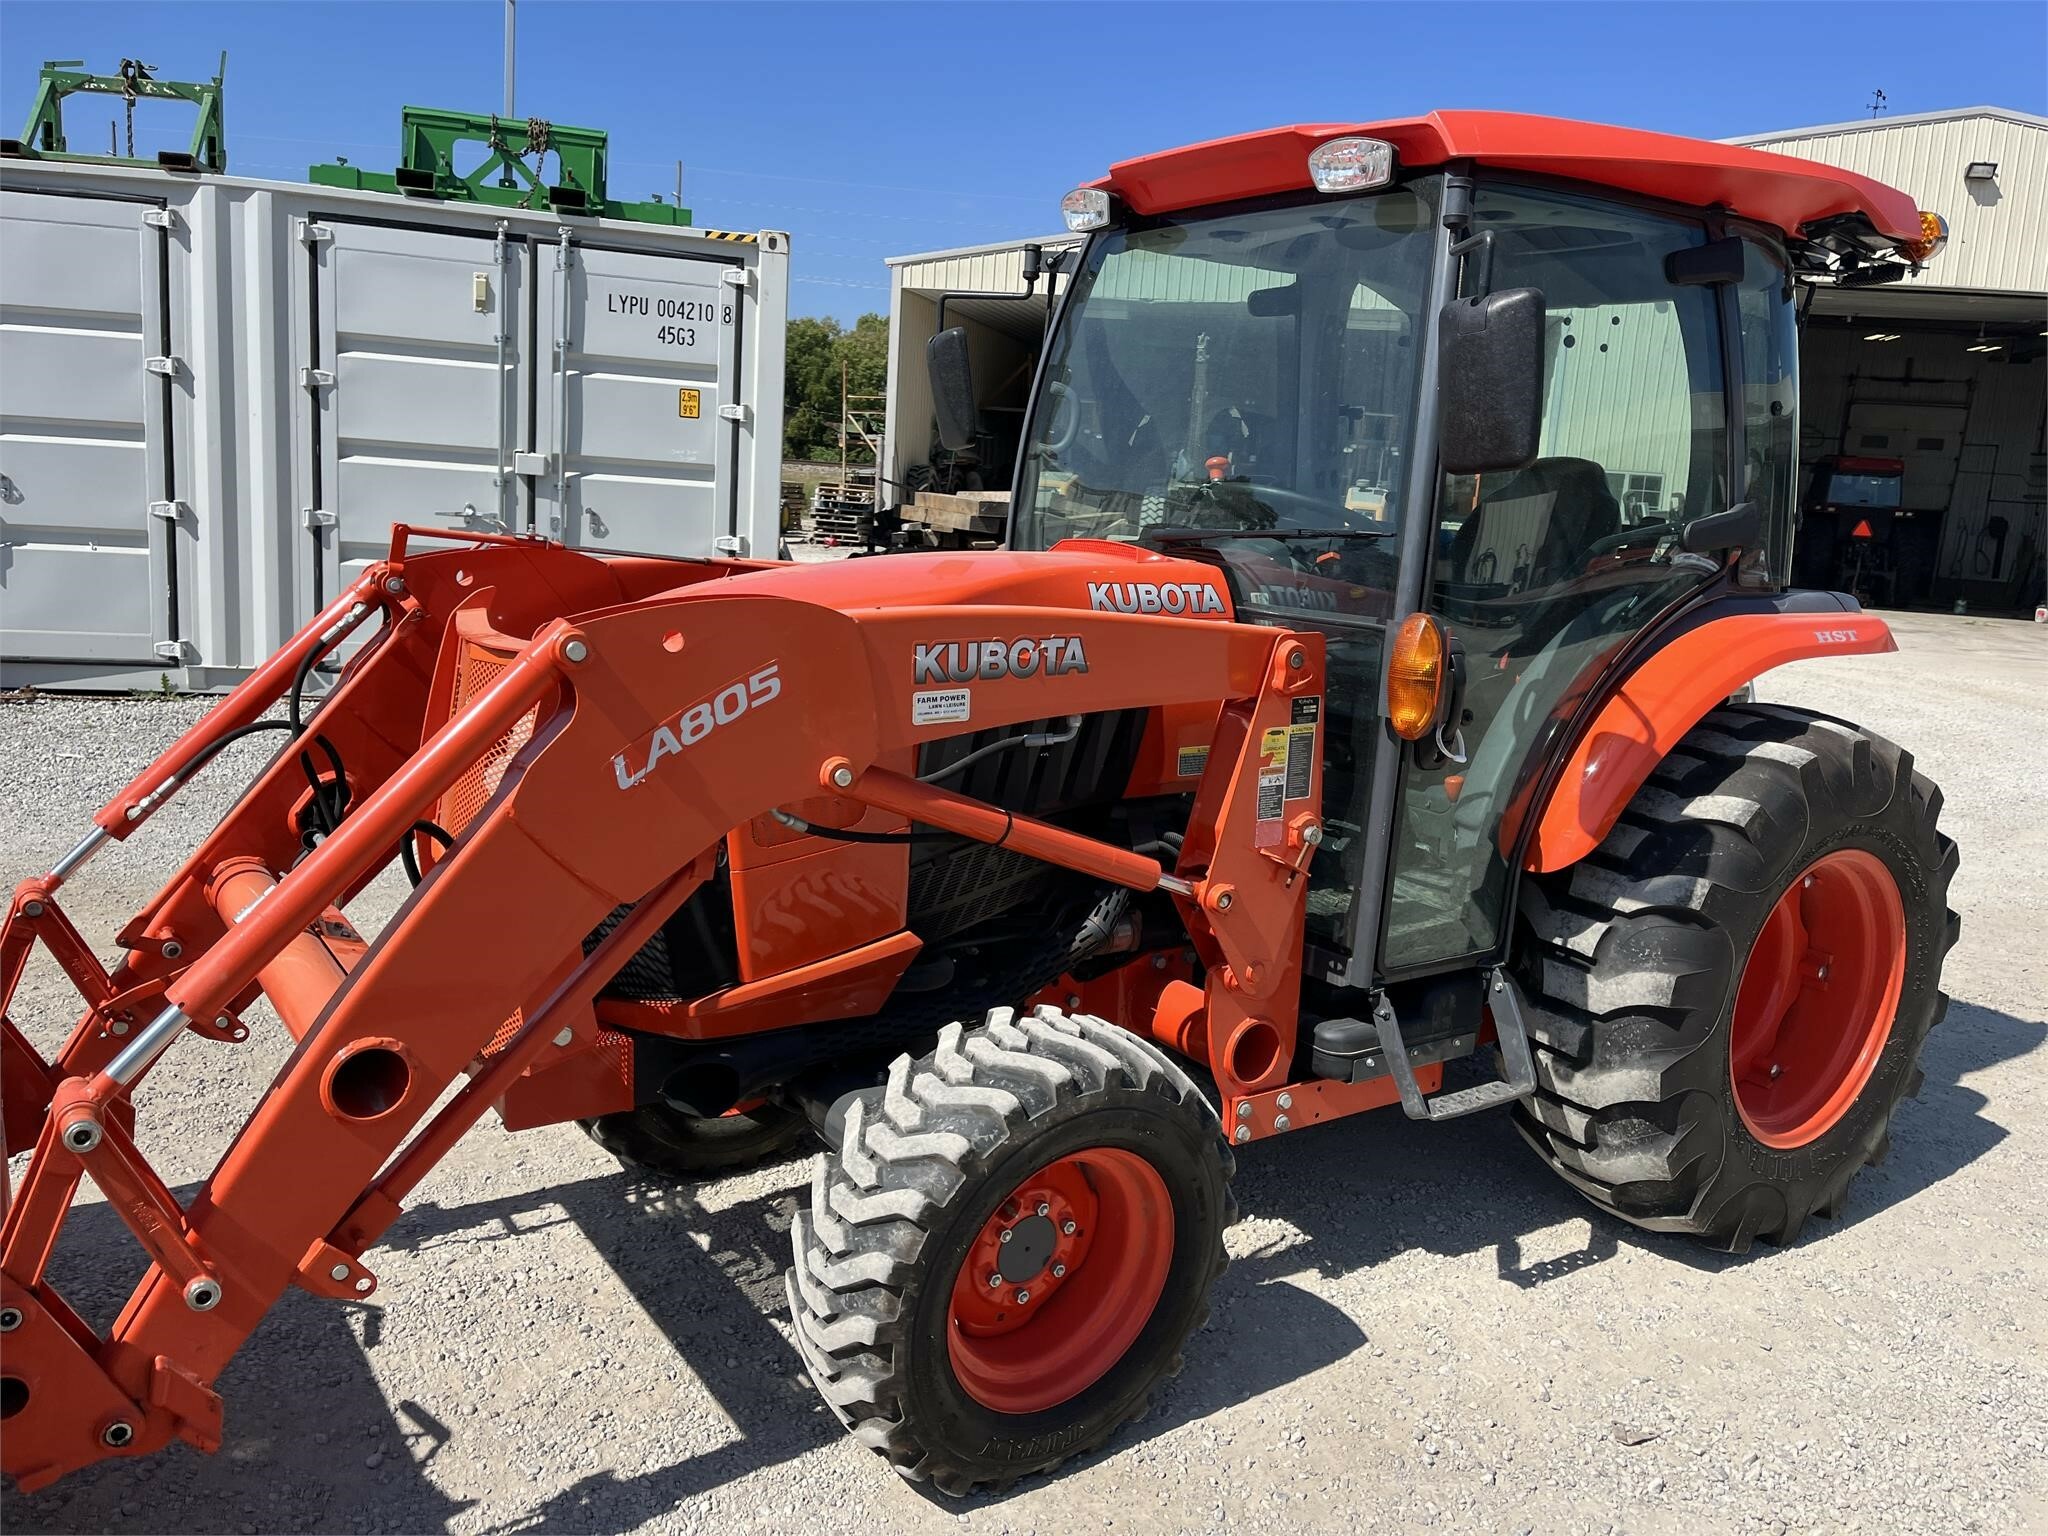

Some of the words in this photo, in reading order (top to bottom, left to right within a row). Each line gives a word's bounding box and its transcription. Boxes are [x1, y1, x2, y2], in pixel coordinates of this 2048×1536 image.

[608, 293, 649, 316] LYPU
[657, 298, 715, 322] 004210
[723, 306, 733, 325] 8
[657, 326, 696, 347] 45G3
[1087, 582, 1226, 614] KUBOTA
[1814, 629, 1858, 644] HST
[914, 636, 1089, 684] KUBOTA
[917, 696, 938, 704] FARM
[940, 694, 966, 703] POWER
[613, 664, 782, 791] LA805
